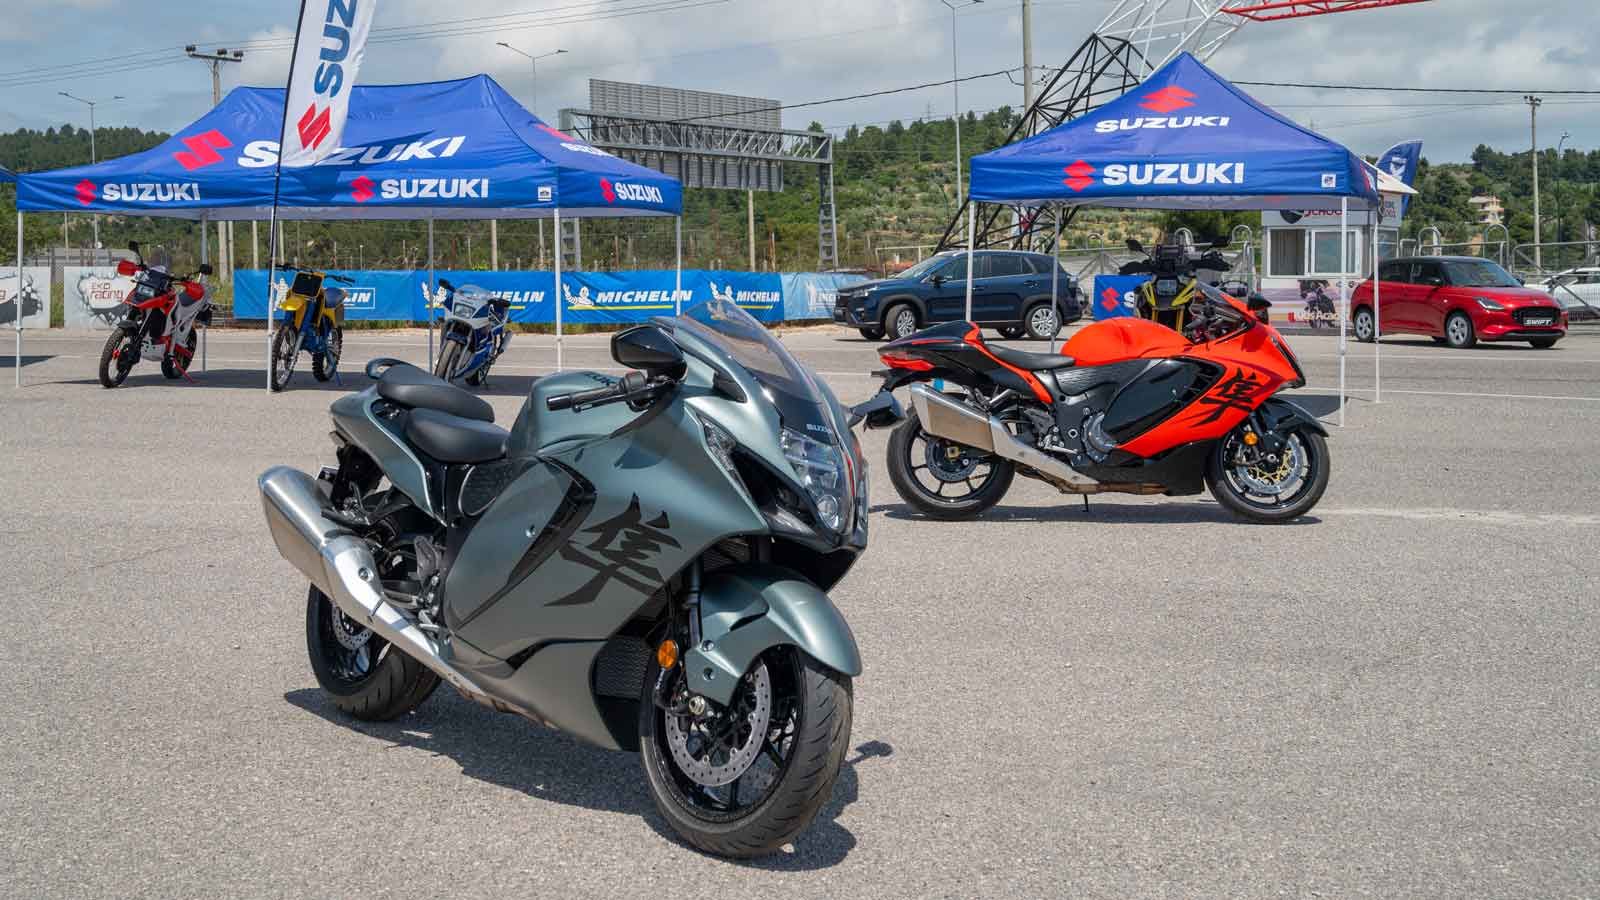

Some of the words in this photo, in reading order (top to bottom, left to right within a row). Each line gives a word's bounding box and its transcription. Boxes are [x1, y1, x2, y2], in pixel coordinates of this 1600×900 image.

[1094, 116, 1230, 133] SUZUKI
[237, 136, 466, 168] SZUKI
[1102, 163, 1245, 185] SUZUKI
[102, 183, 200, 201] SUZUKI
[381, 178, 489, 199] SUZUKI
[614, 182, 664, 204] SUZUKI
[596, 290, 693, 303] MICHELIN
[736, 290, 780, 302] MICHELIN
[544, 491, 682, 607] 隼
